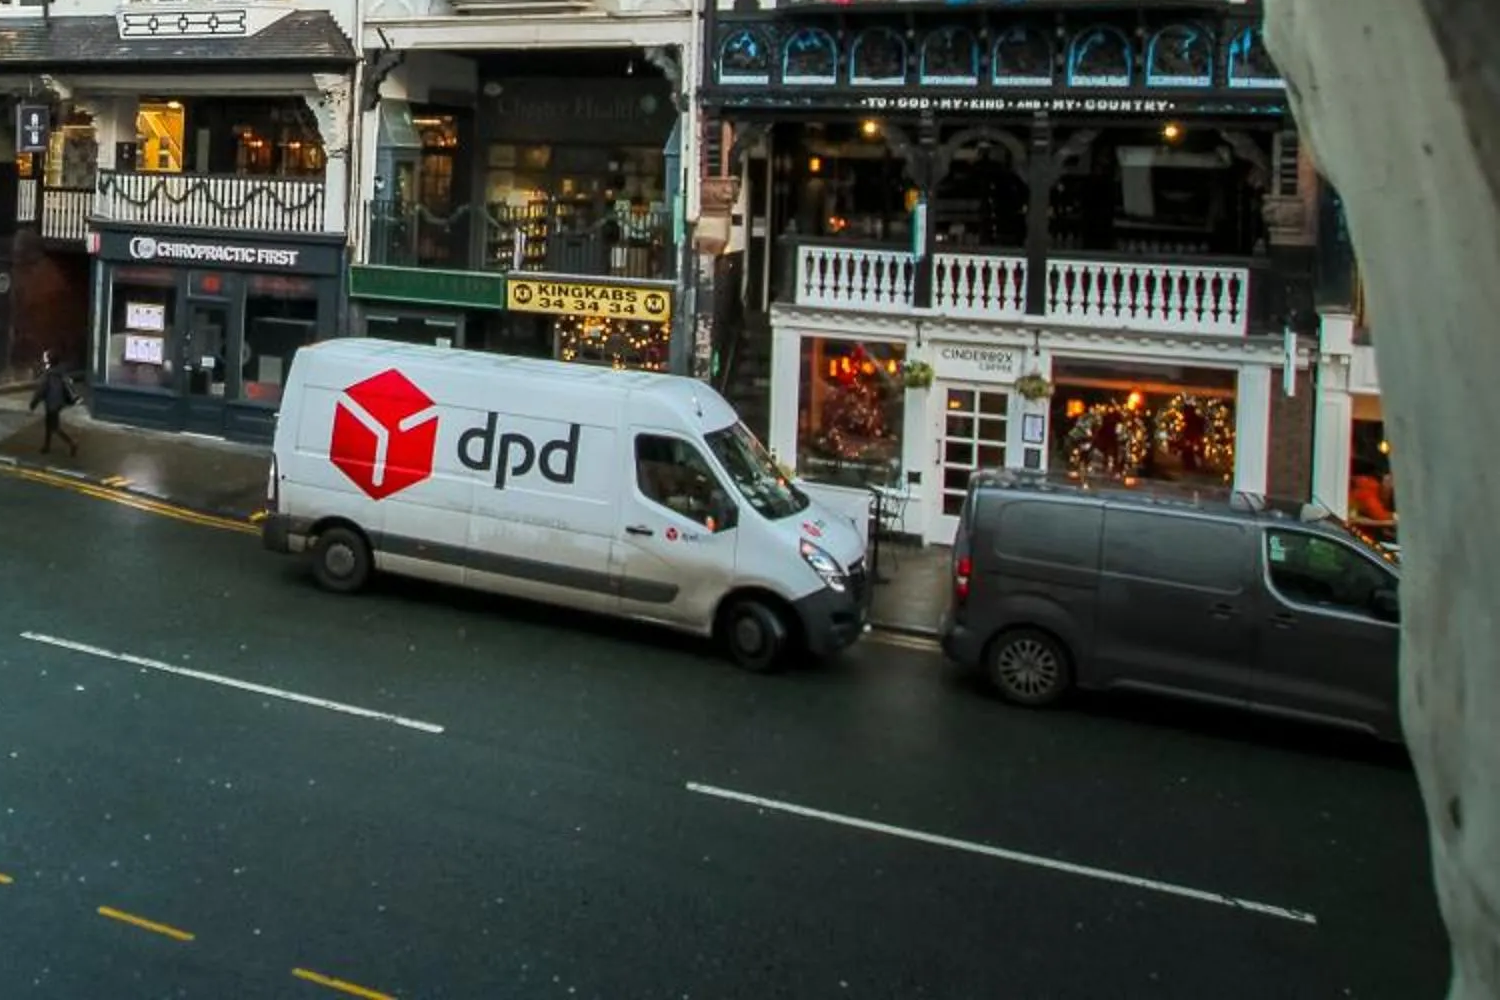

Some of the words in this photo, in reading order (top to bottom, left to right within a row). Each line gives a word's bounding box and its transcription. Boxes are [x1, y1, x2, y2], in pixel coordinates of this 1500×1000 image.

[867, 97, 887, 109] TO
[897, 97, 930, 109] GOD
[940, 98, 962, 110] MY
[970, 98, 1005, 110] KING
[1016, 100, 1041, 109] AND
[1052, 99, 1075, 111] MY
[1084, 98, 1169, 112] COUNTRY
[156, 242, 257, 263] CHIROPRACTIC
[257, 249, 300, 265] FIRST
[537, 284, 638, 302] KINGKABS
[539, 297, 565, 309] 34
[574, 299, 599, 313] 34
[608, 302, 636, 315] 34
[457, 411, 581, 490] dpd
